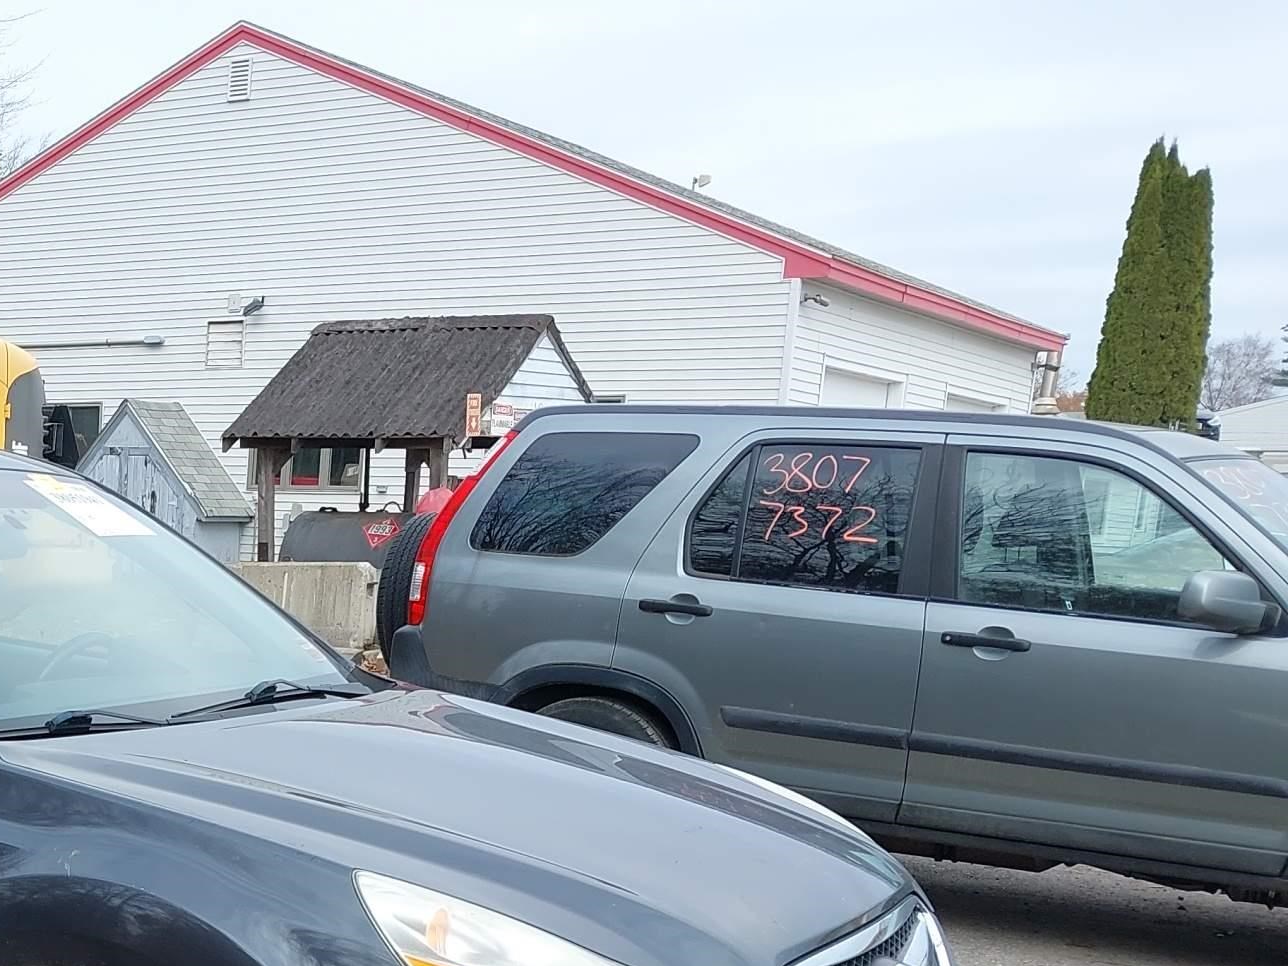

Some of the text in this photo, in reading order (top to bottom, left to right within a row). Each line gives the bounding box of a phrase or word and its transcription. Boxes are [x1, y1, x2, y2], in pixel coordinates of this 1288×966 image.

[763, 452, 871, 495] 3807
[369, 524, 392, 535] 1993
[759, 500, 879, 543] 7372
